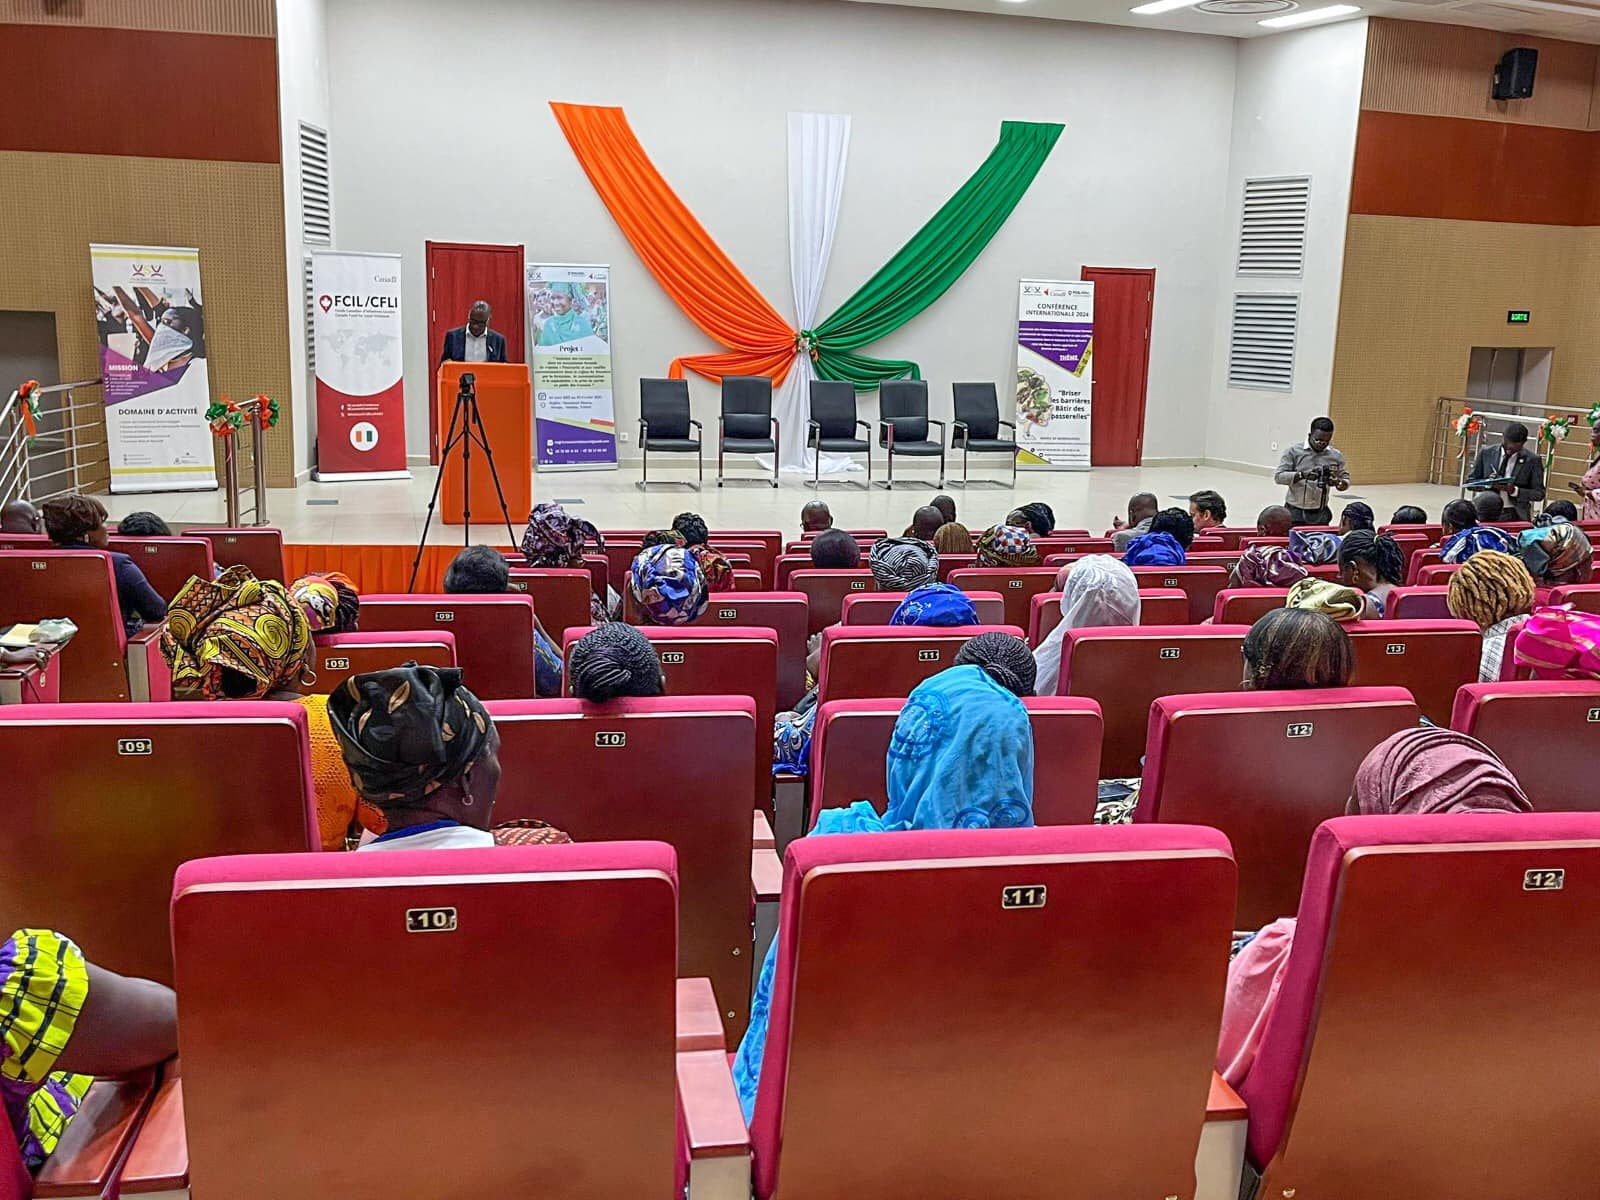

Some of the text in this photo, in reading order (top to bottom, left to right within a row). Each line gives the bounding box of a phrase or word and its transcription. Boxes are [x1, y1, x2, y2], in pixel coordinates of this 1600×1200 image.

[118, 408, 155, 416] DOMAINE
[667, 654, 680, 662] 10
[330, 660, 345, 668] 09
[1293, 725, 1308, 735] 12
[602, 734, 620, 744] 10
[125, 742, 145, 752] 09
[1533, 872, 1556, 886] 12
[1012, 889, 1035, 904] 11
[418, 911, 447, 928] 10
